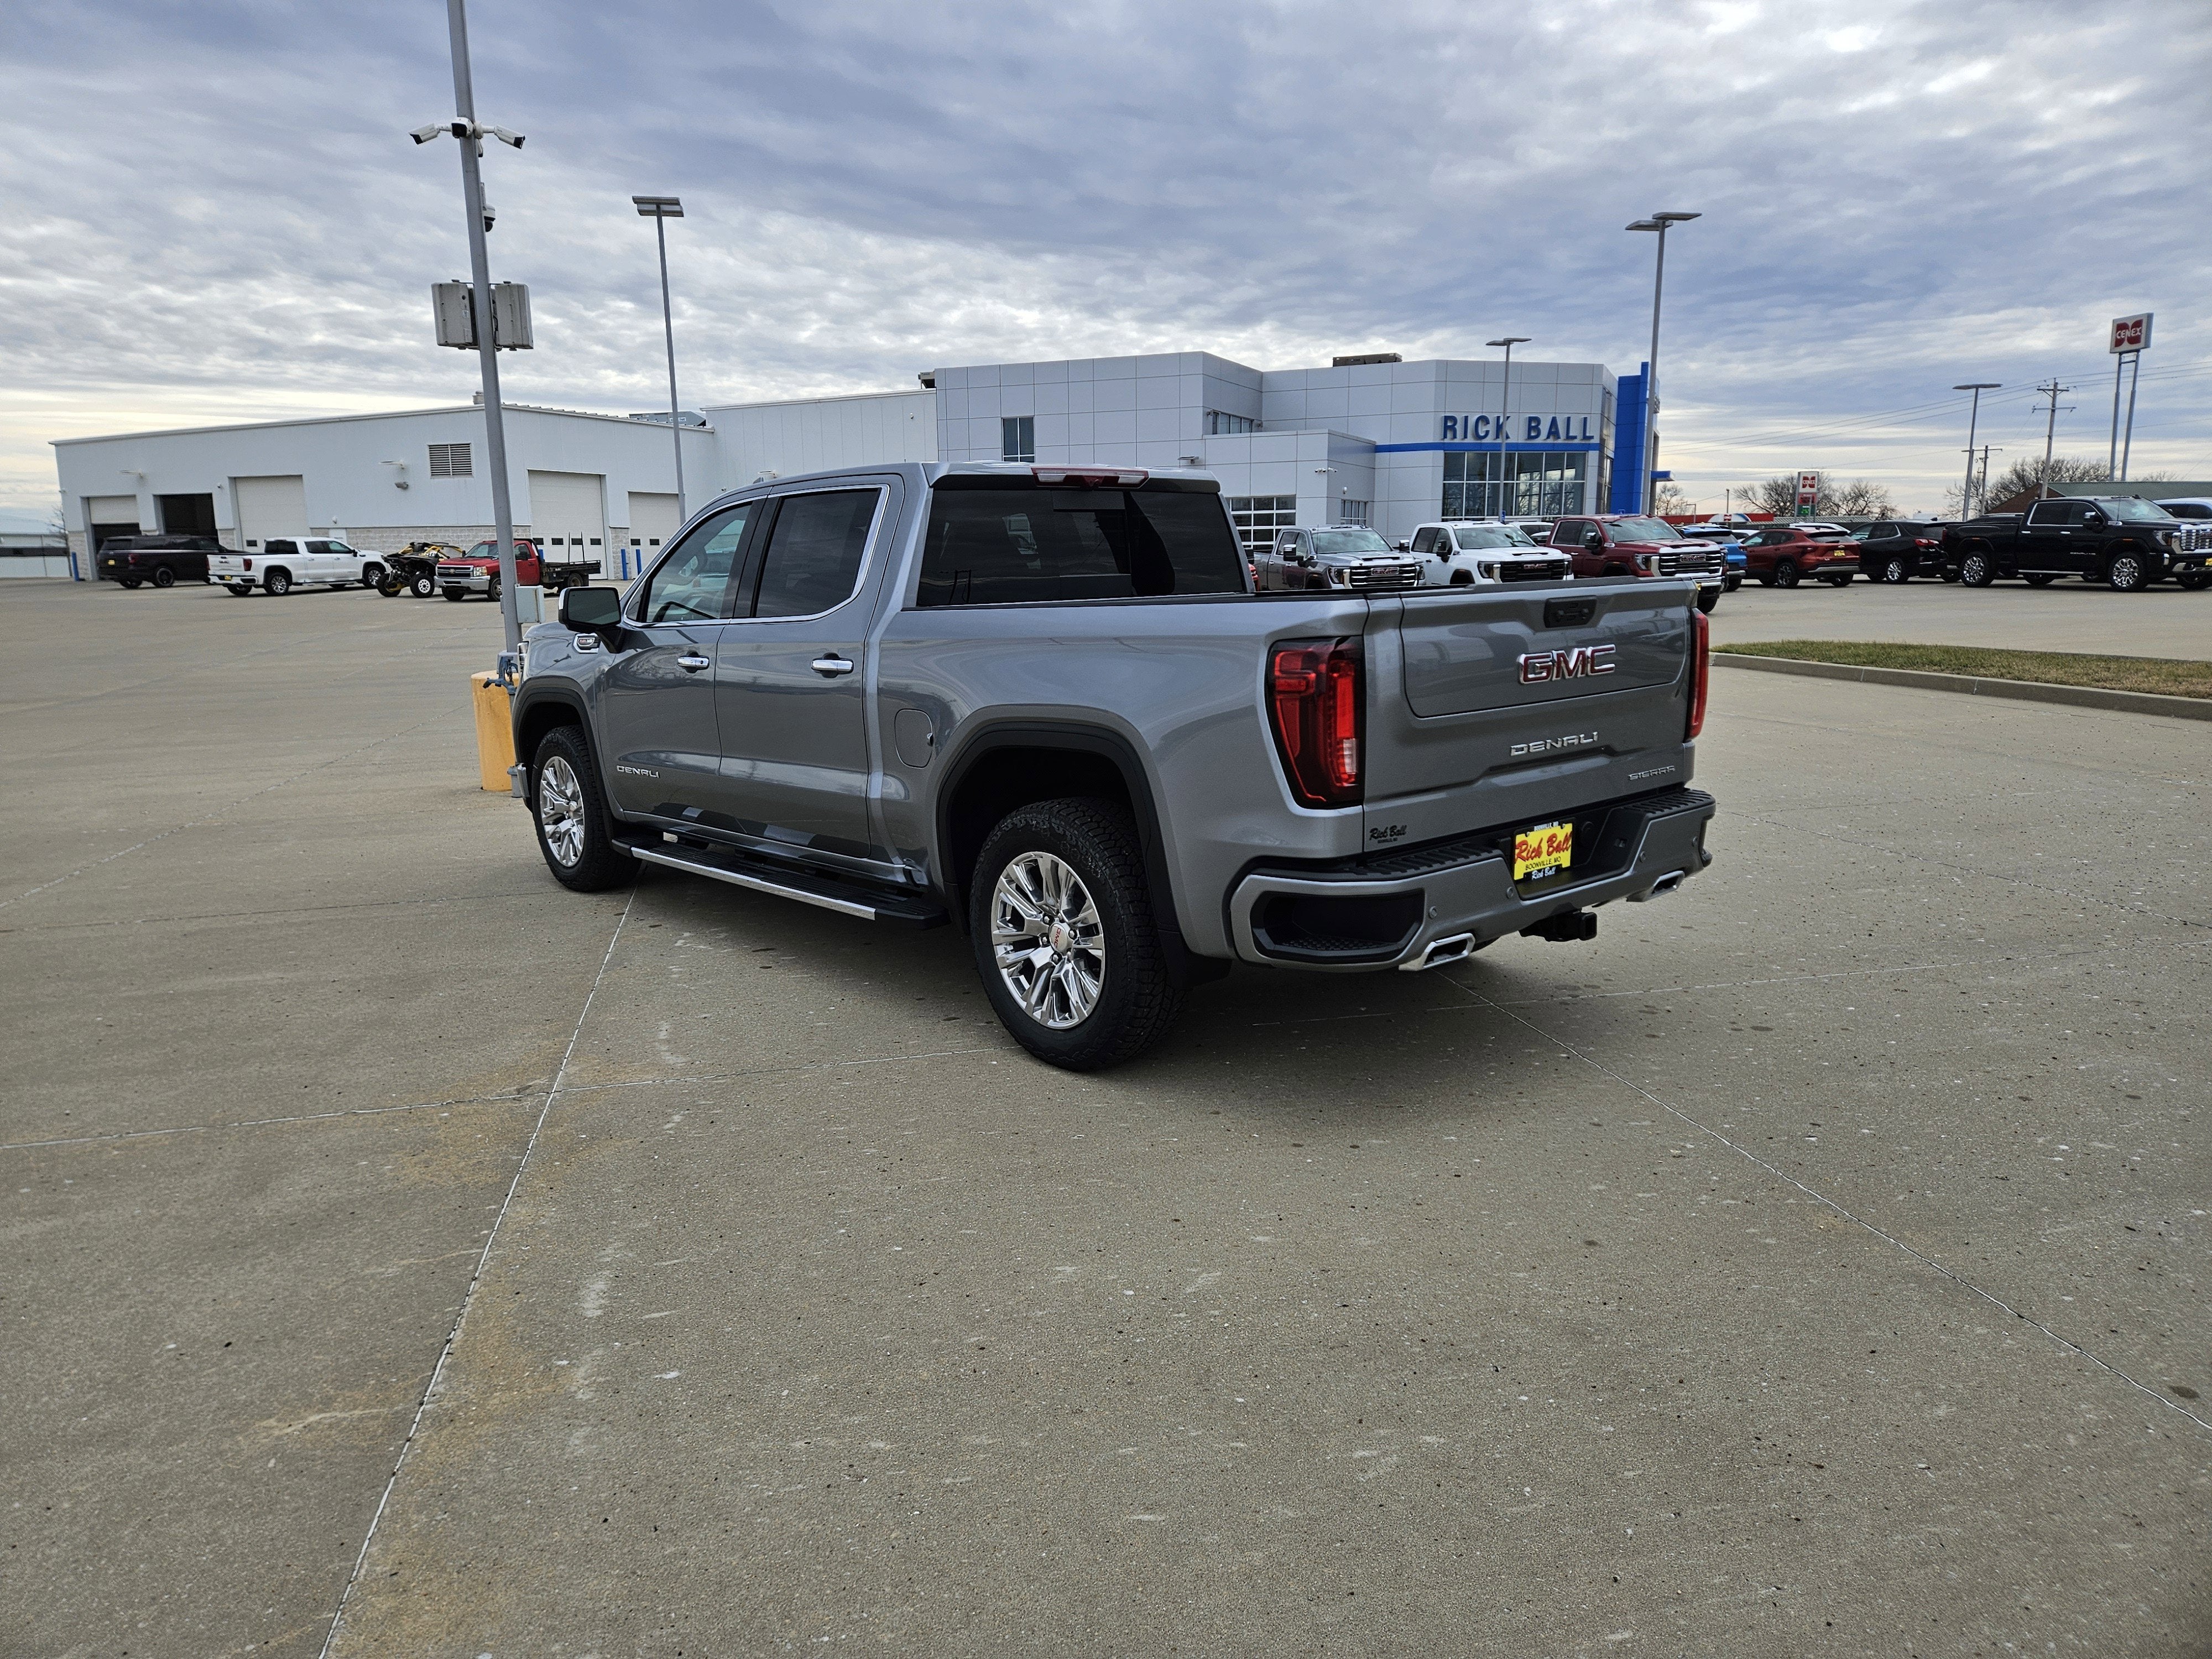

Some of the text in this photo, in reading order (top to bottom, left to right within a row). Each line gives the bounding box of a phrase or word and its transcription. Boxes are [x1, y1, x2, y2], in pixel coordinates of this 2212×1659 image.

[2116, 327, 2142, 339] CENEX
[1443, 415, 1594, 440] RICK BALL
[1517, 644, 1616, 684] GMC
[1510, 732, 1598, 756] DENALI
[617, 765, 660, 778] DENALI
[1628, 765, 1675, 780] SIERRA
[1369, 826, 1389, 841] Rick
[1389, 825, 1407, 837] Ball
[1514, 831, 1572, 864] Rick Ball
